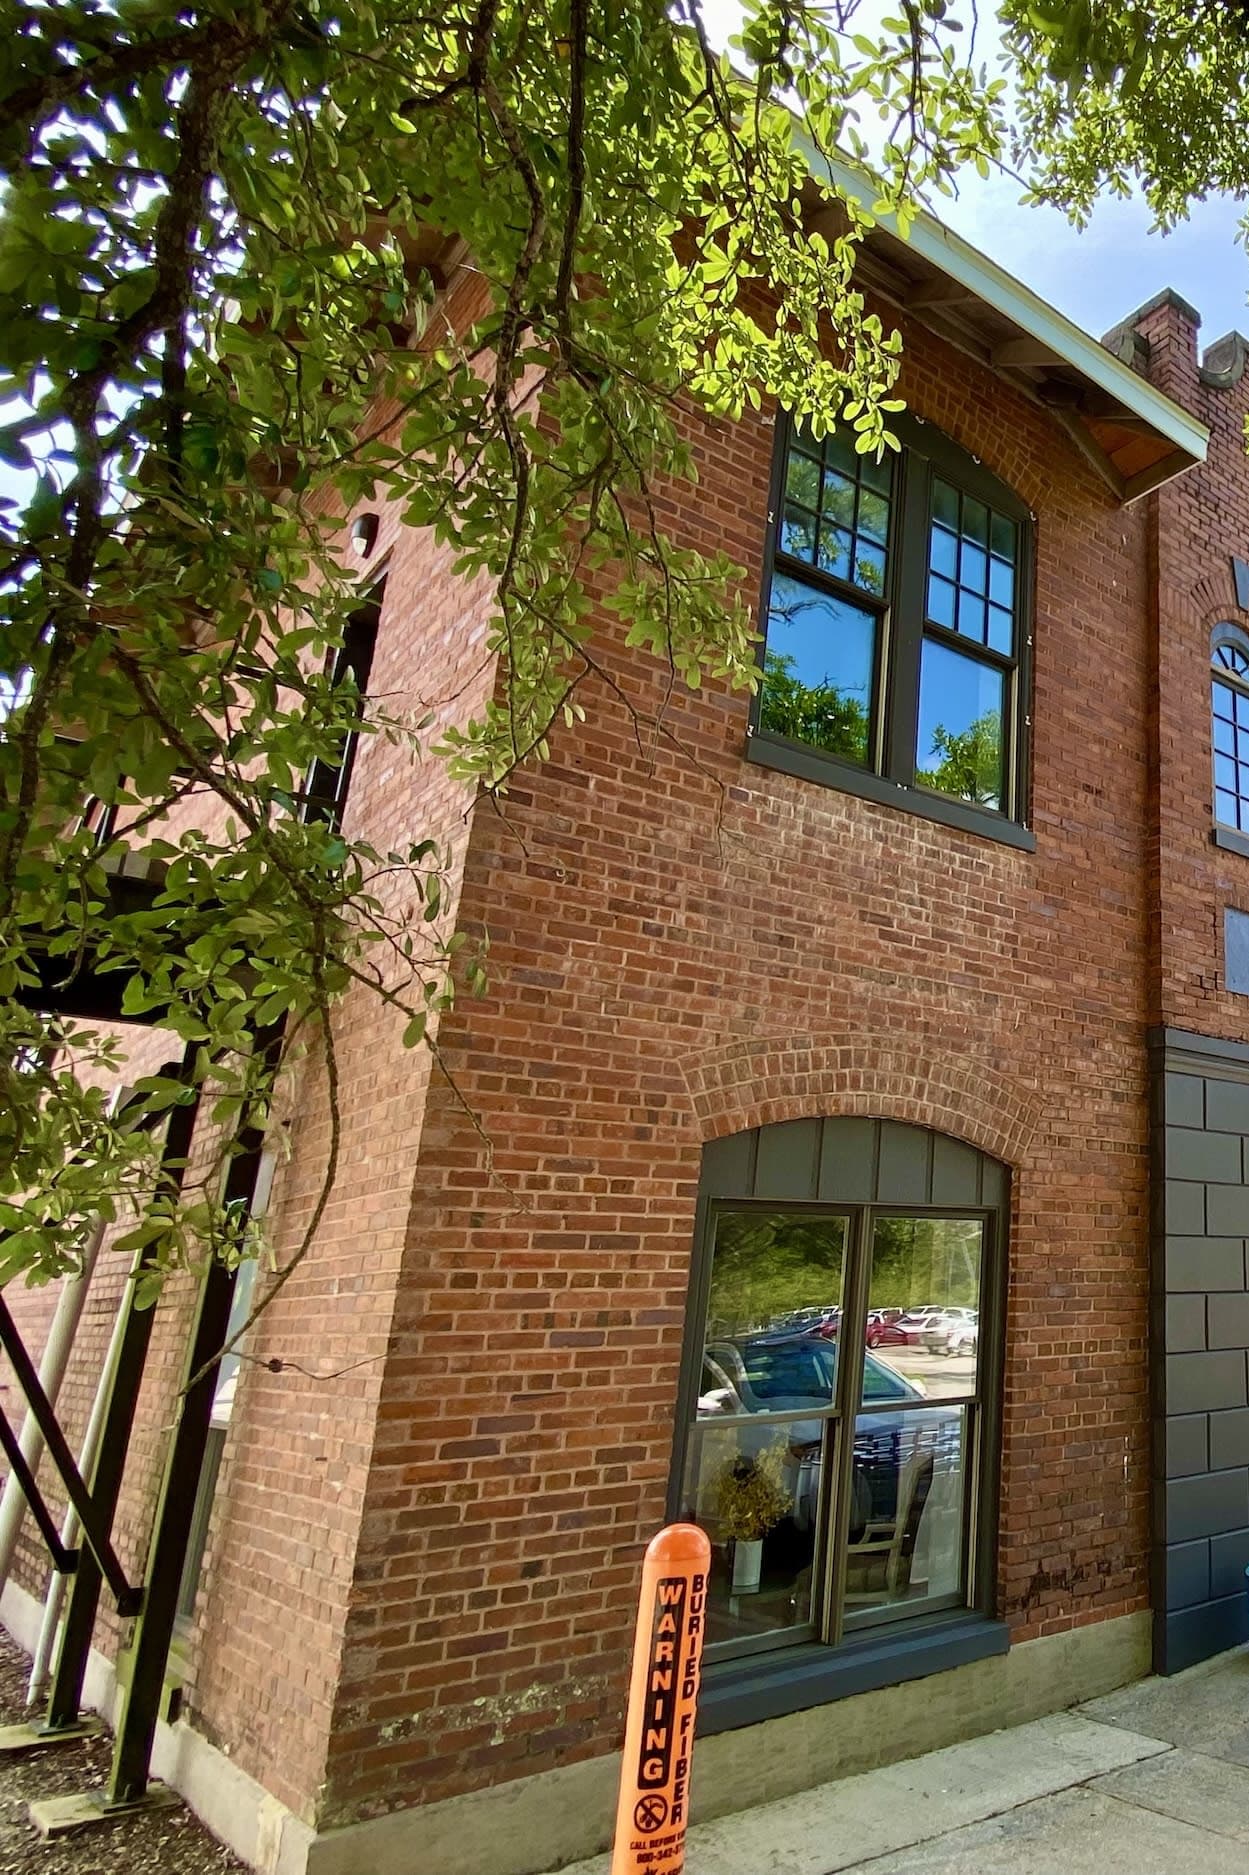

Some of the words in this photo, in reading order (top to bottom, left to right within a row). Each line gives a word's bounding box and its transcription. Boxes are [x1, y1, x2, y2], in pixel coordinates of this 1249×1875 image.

[643, 1584, 683, 1780] WARNING
[682, 1574, 704, 1699] BURIED
[671, 1713, 692, 1826] FIBER
